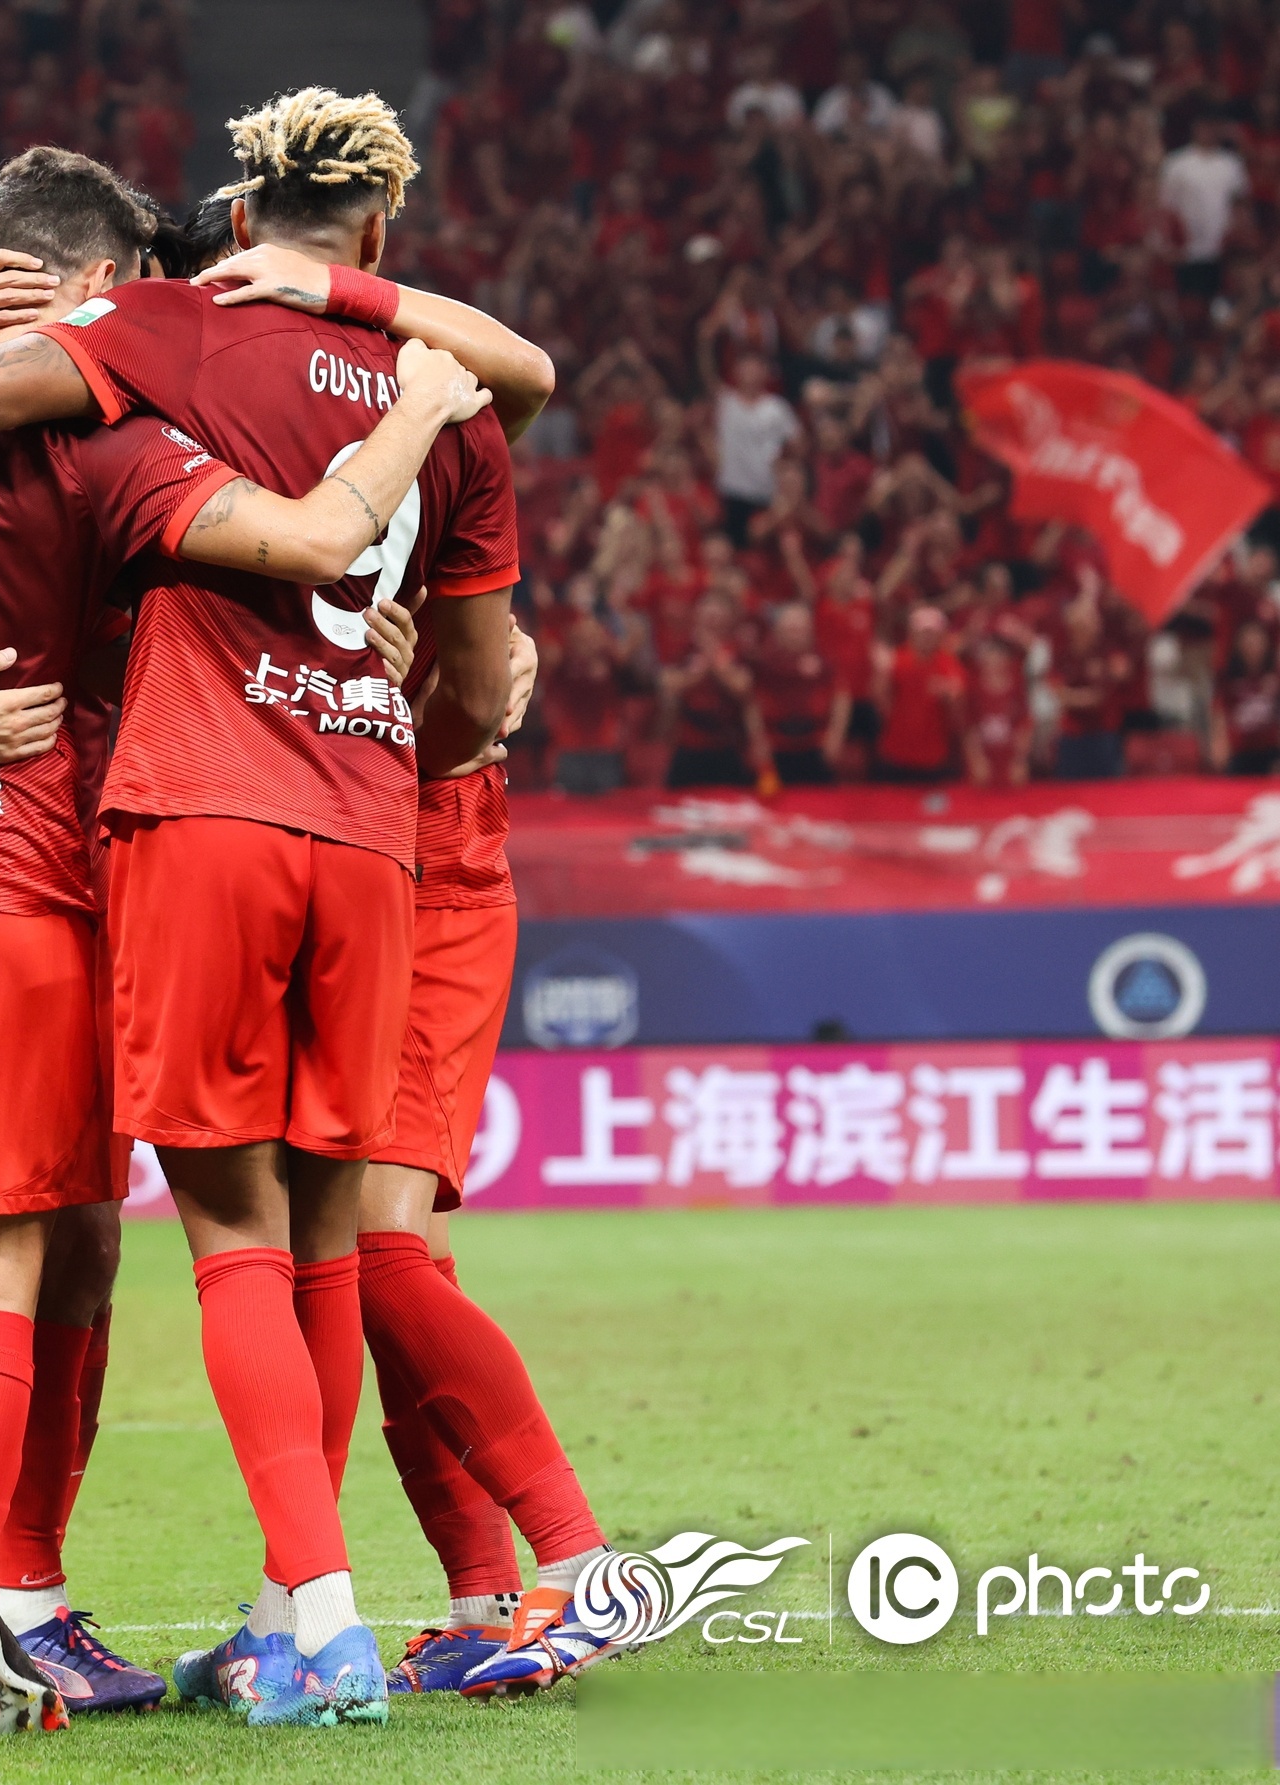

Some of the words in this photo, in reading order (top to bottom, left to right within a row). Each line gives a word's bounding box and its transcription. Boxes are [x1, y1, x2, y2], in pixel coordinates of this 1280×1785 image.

[311, 440, 421, 651] 9
[244, 652, 414, 726] 上汽集团
[542, 1058, 1277, 1189] 上海滨江生活
